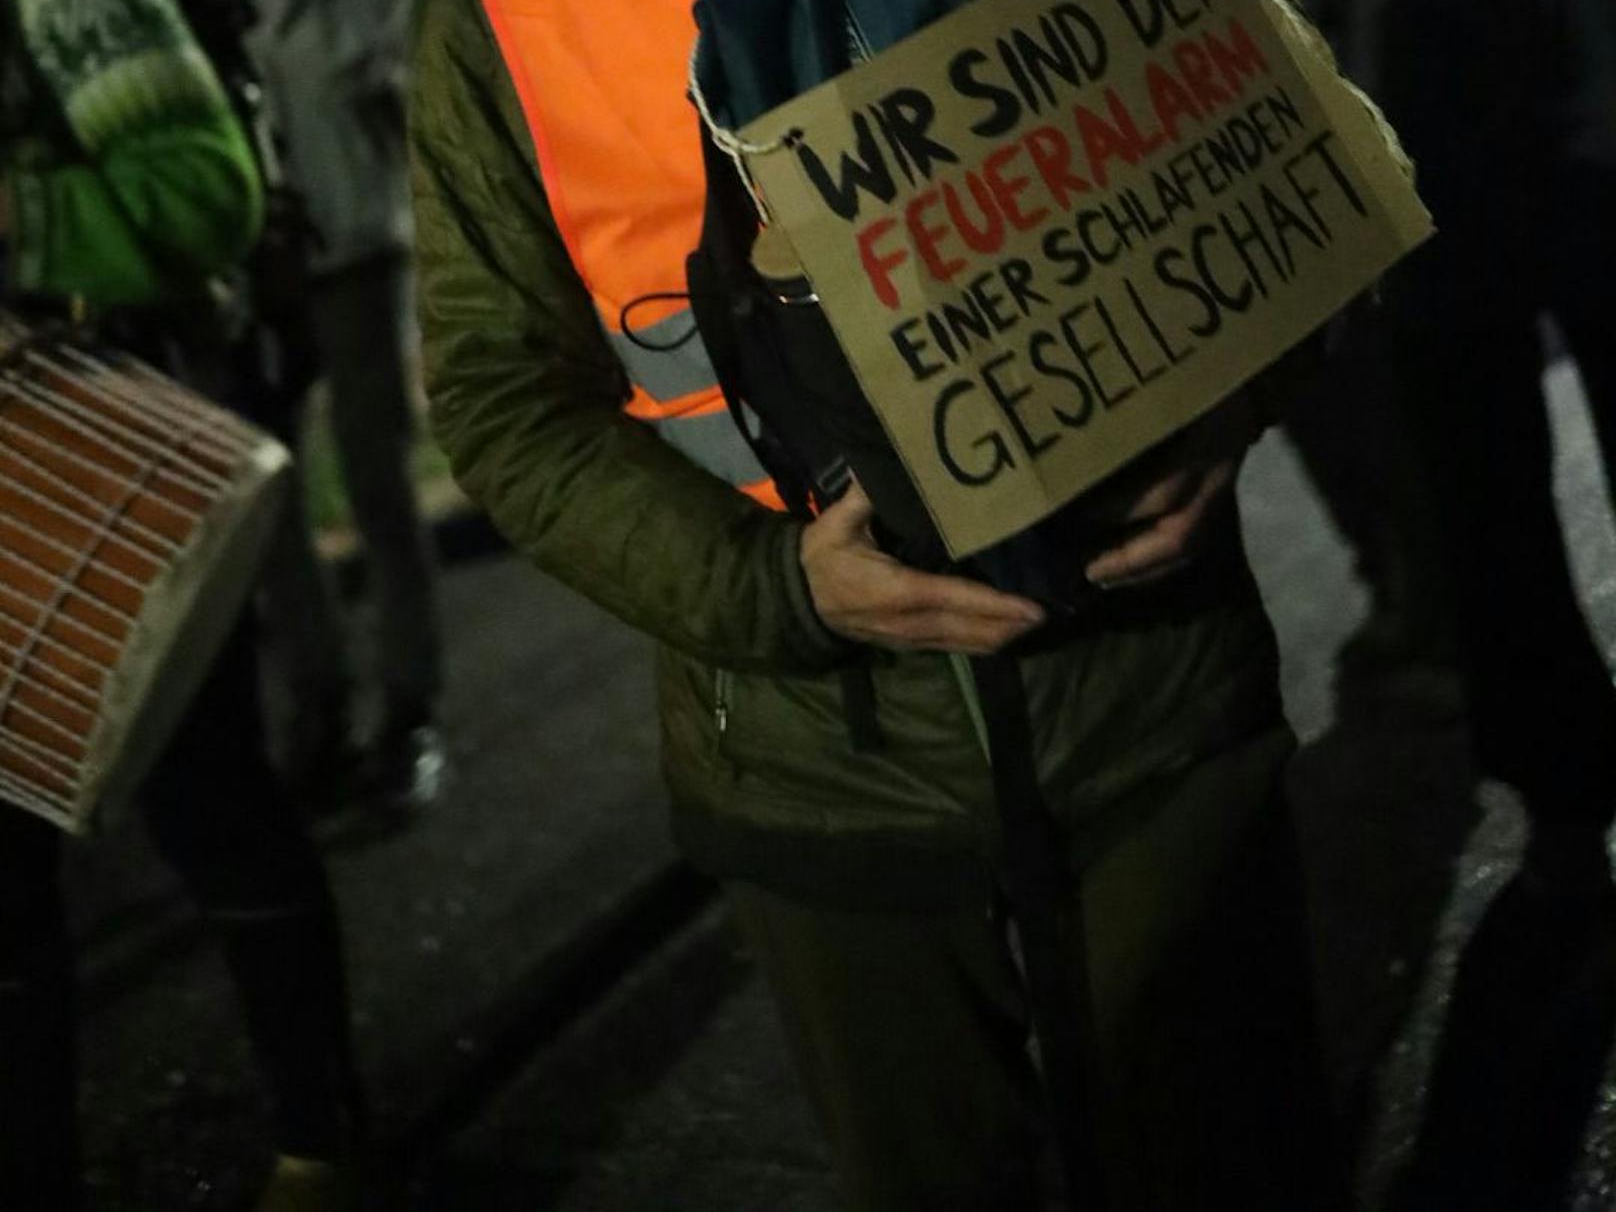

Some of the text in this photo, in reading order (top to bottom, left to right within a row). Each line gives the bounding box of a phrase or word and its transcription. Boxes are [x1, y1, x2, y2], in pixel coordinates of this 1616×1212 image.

[797, 87, 957, 221] WIR
[949, 2, 1107, 137] SIND
[856, 20, 1270, 310] FEUERALARM
[892, 85, 1305, 381] EINER SCHLAFENDEN
[932, 131, 1368, 487] GESELLSCHAFT
